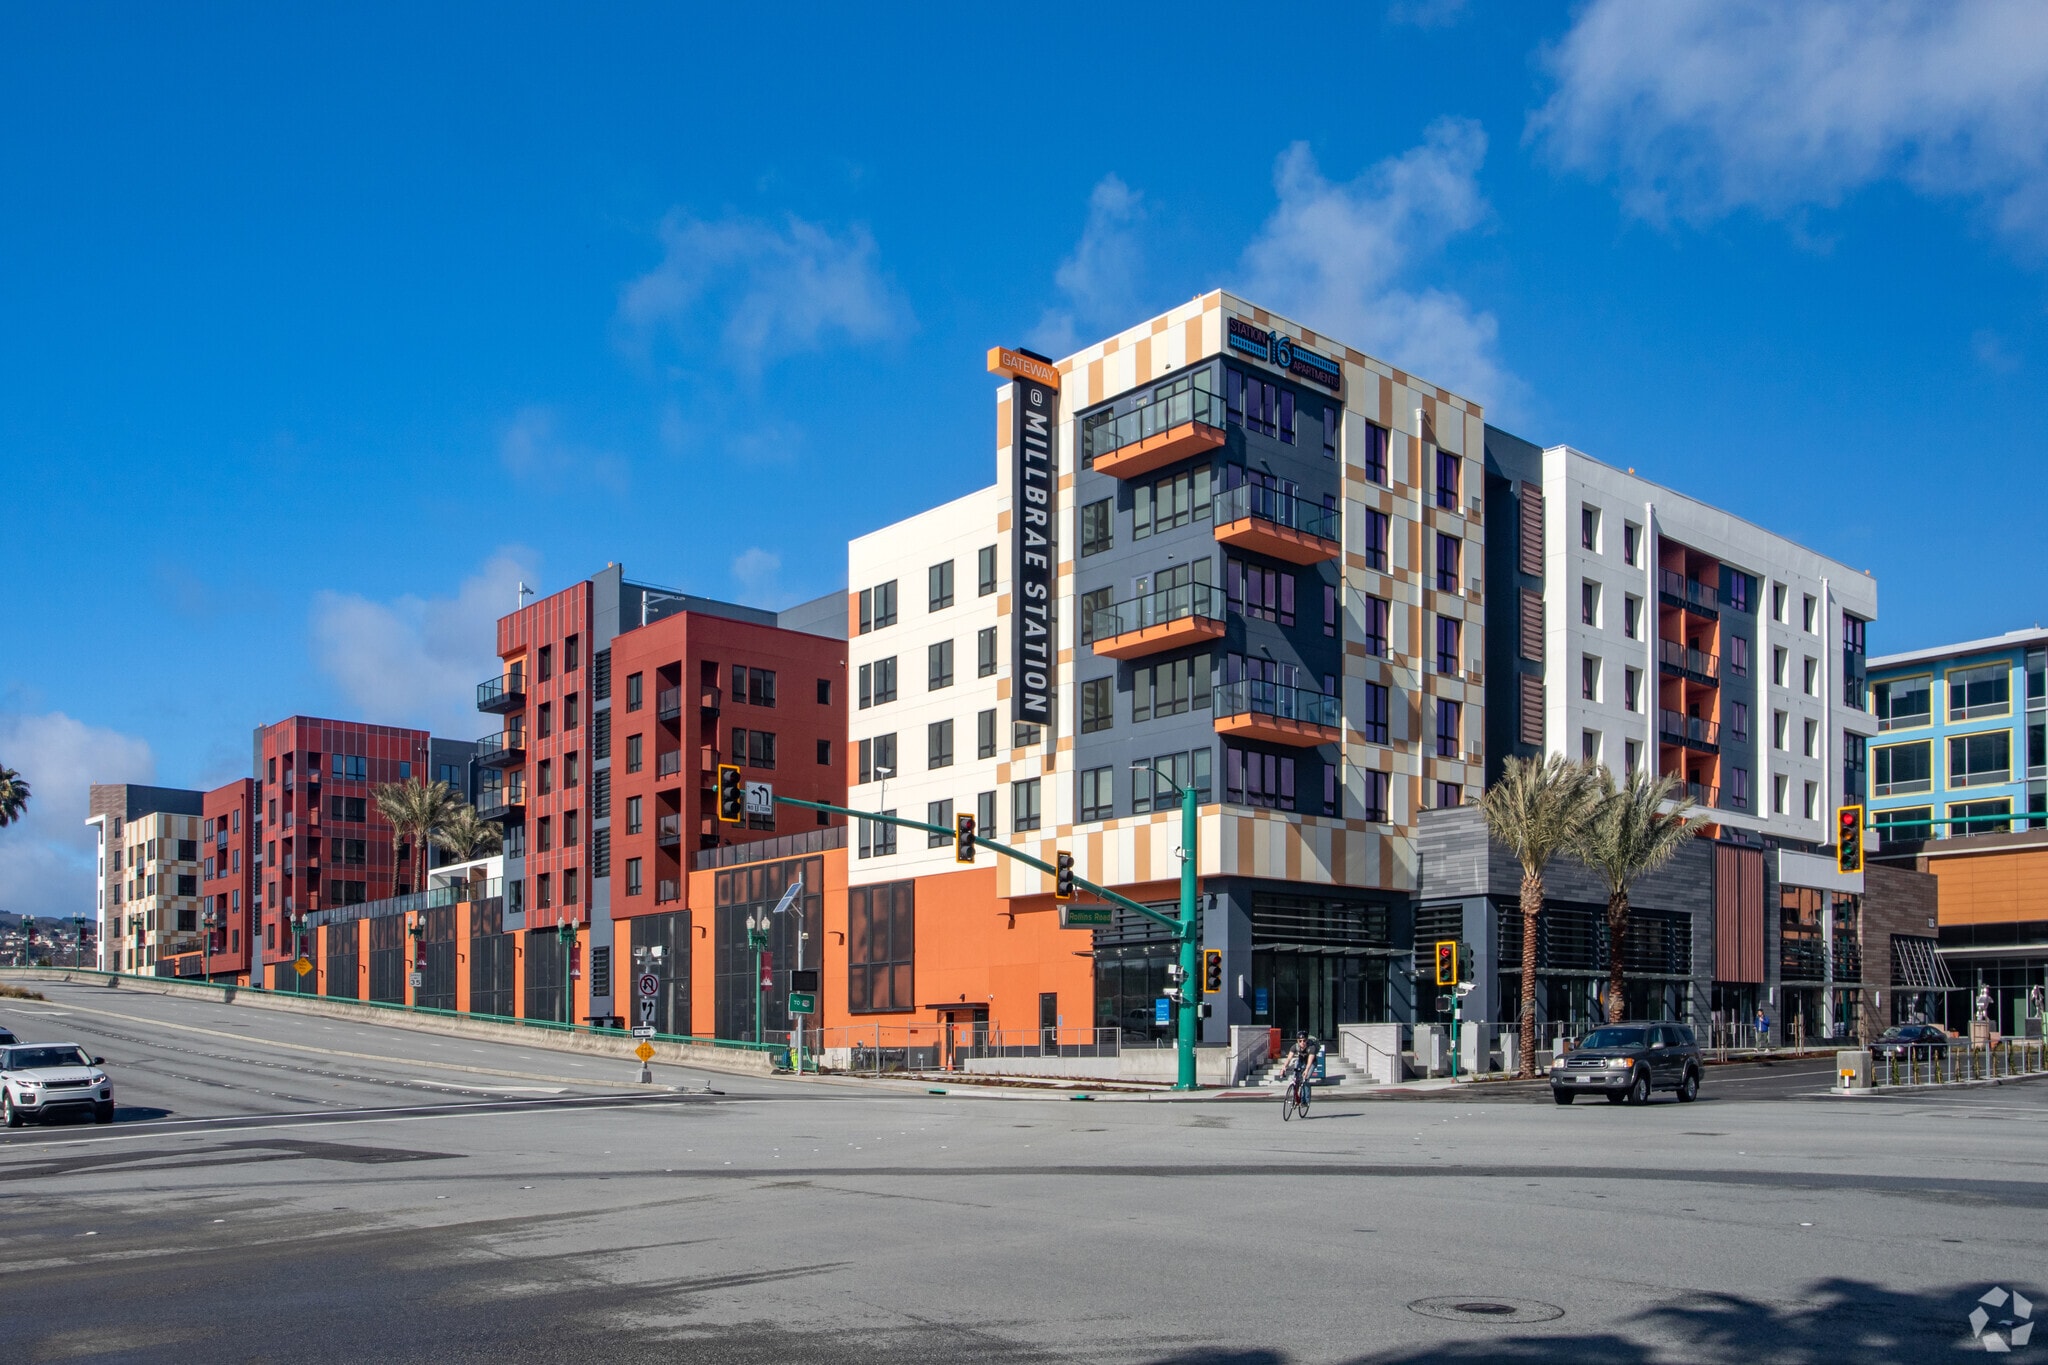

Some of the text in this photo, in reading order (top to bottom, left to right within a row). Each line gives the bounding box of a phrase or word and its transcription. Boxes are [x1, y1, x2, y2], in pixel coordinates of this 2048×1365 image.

[1230, 320, 1266, 344] STATION
[1268, 330, 1292, 368] 16
[1002, 352, 1054, 381] GATEWAY
[1292, 361, 1339, 388] APARTMENTS
[1025, 388, 1048, 713] @ MILLBRAE STATION
[1069, 912, 1111, 921] Rollins Road
